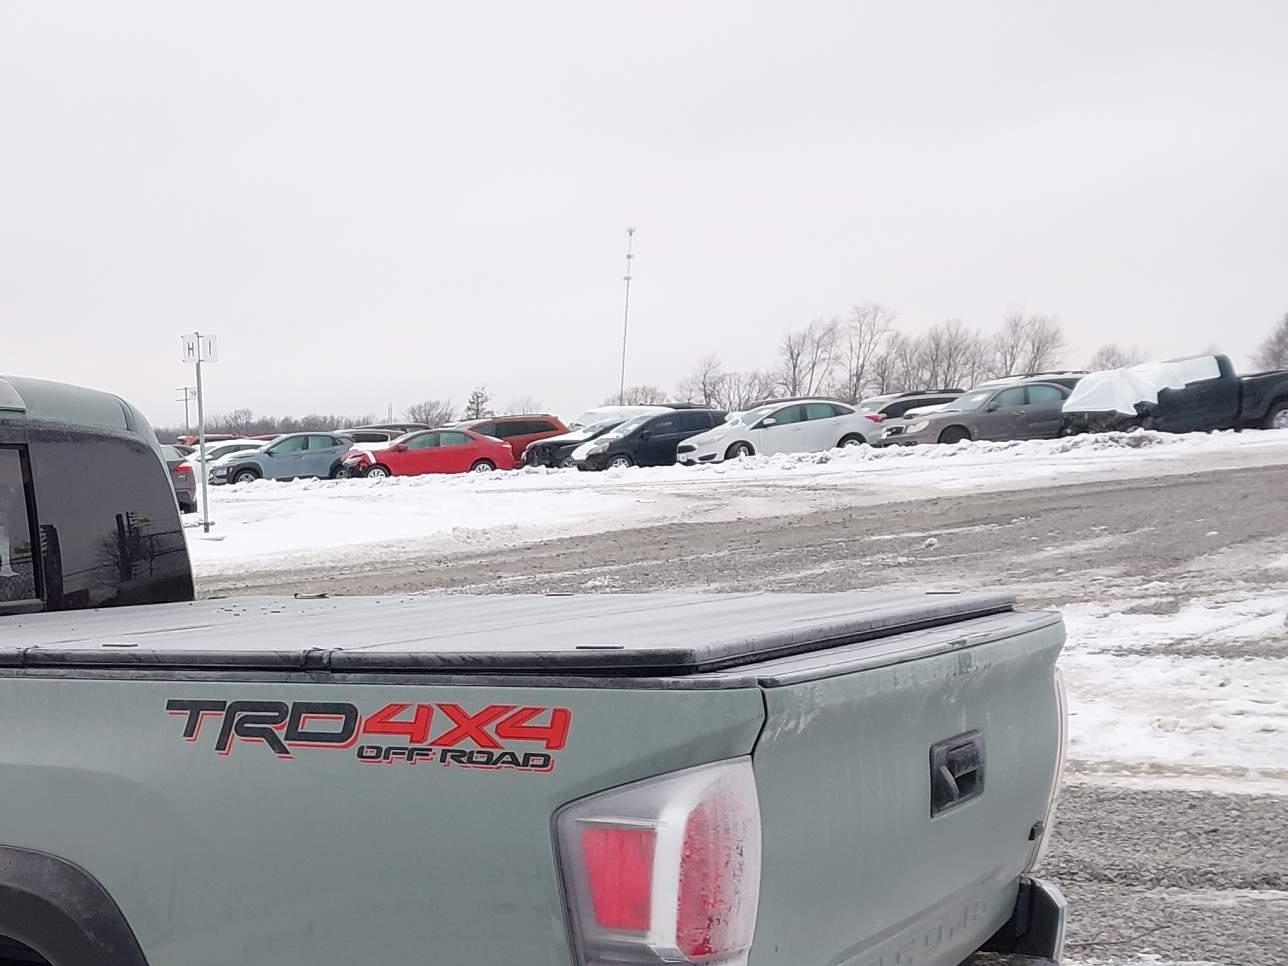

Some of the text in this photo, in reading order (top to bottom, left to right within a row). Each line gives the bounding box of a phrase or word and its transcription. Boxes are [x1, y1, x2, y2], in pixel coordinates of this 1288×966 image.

[187, 341, 195, 357] H
[165, 699, 573, 759] TRD 4X4
[355, 744, 555, 772] OFF ROAD
